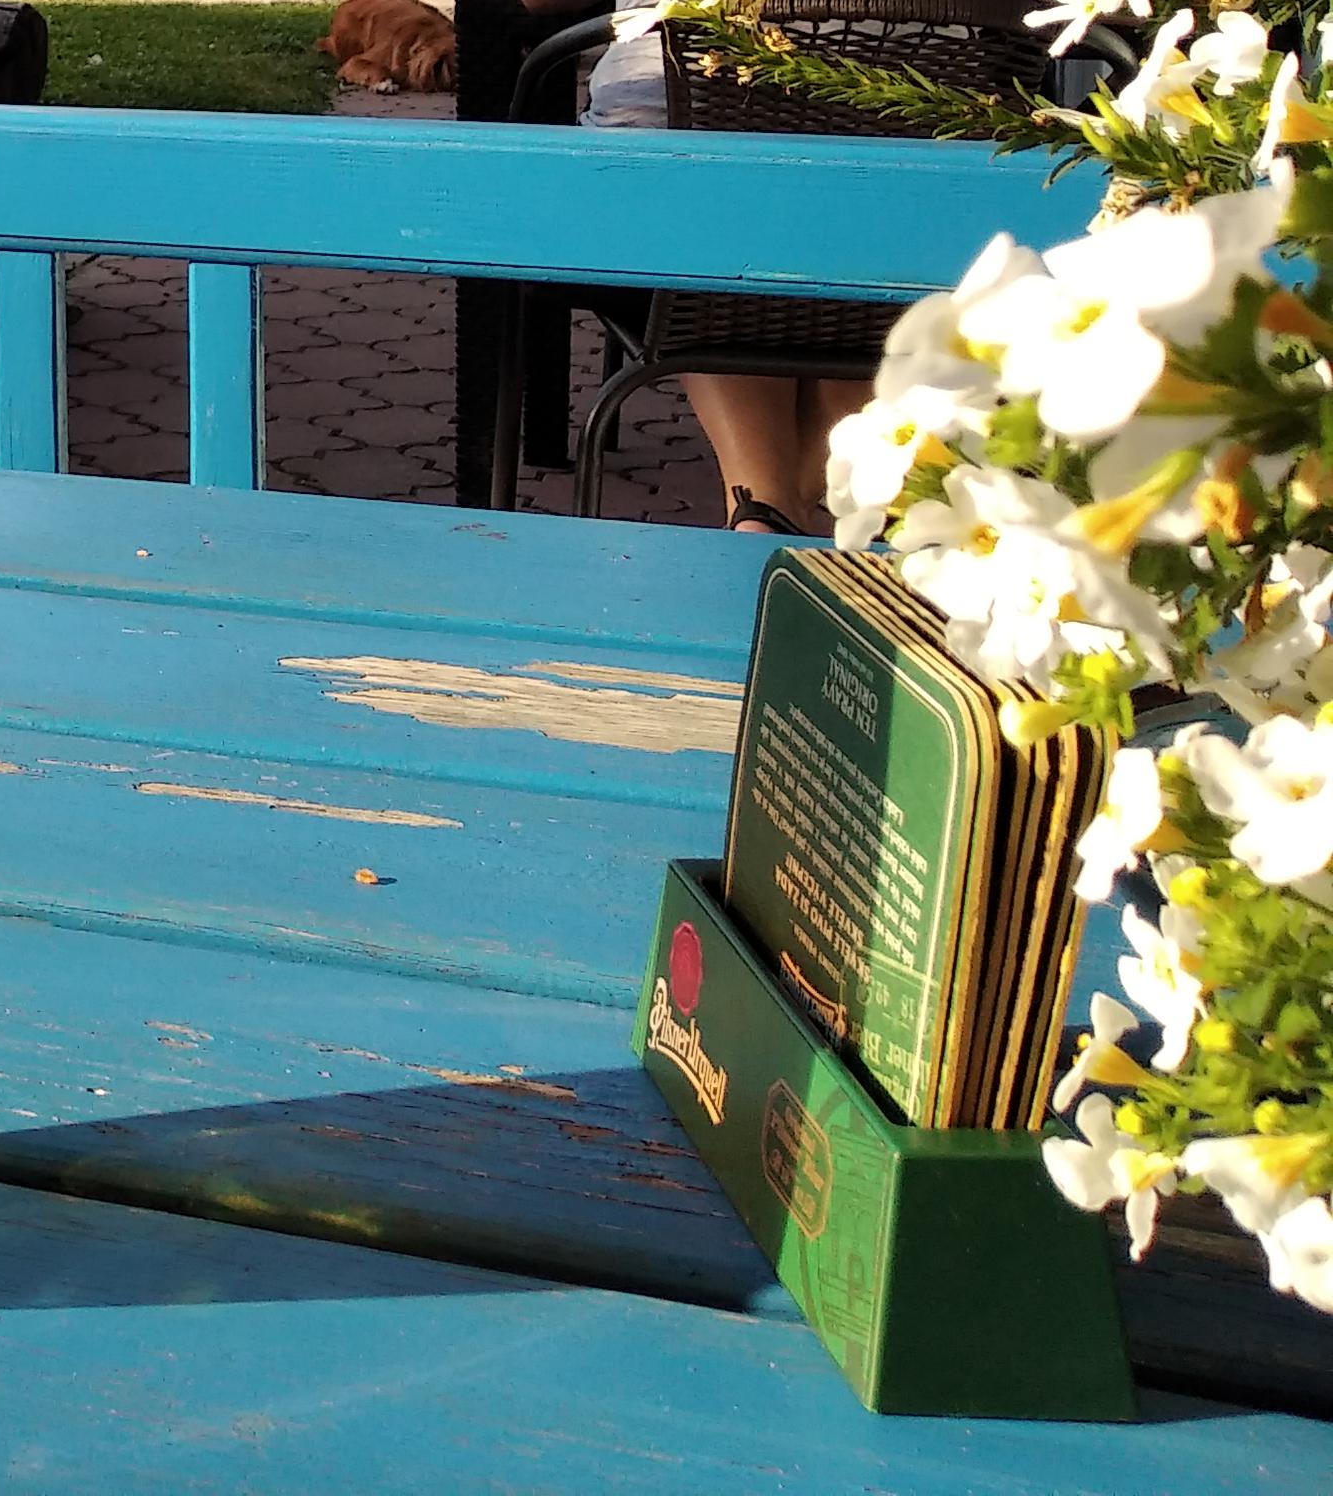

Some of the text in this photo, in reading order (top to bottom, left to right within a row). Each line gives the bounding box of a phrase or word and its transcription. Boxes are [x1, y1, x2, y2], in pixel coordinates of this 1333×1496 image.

[837, 707, 876, 742] TEN
[810, 906, 833, 943] PIVO
[648, 977, 727, 1111] Pilsner Urquell
